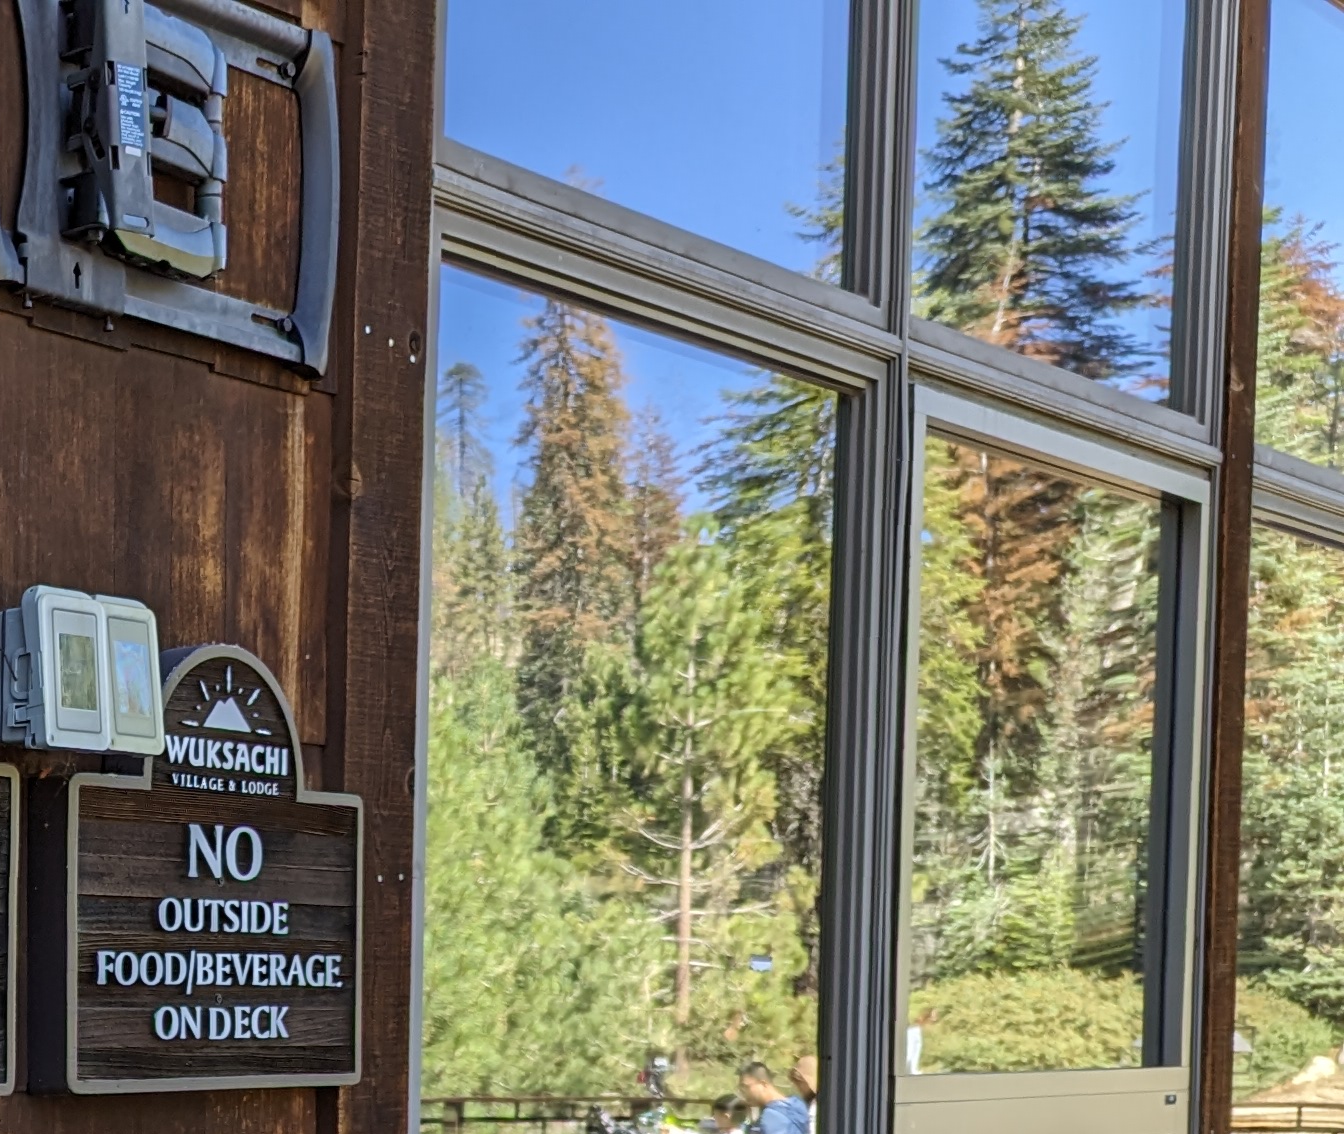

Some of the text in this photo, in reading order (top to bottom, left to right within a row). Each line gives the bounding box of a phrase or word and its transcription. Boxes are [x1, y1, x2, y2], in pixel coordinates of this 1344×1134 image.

[165, 734, 289, 776] WUKSACHI
[171, 773, 280, 797] VILLAGE & LODGE
[187, 823, 264, 881] NO
[158, 896, 290, 935] OUTSIDE
[96, 950, 343, 995] FOOD/BEVERAGE
